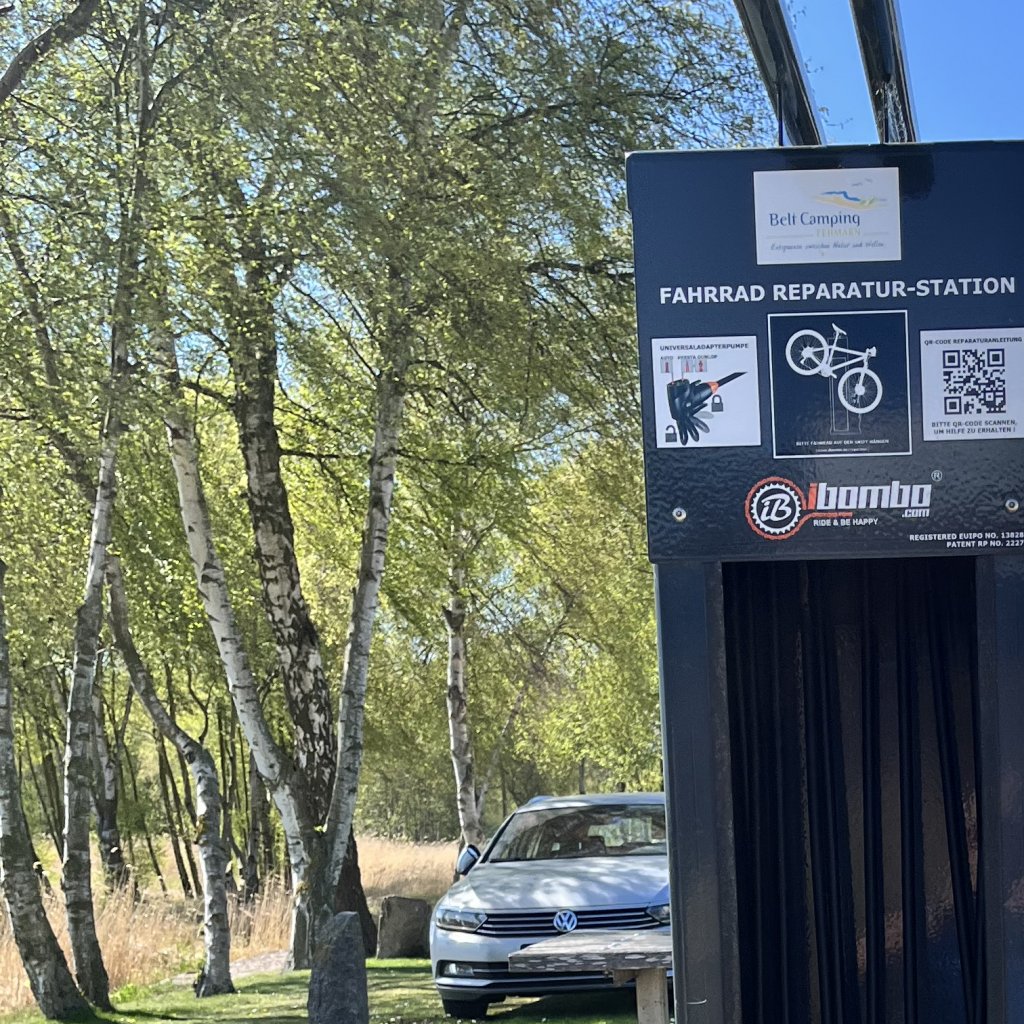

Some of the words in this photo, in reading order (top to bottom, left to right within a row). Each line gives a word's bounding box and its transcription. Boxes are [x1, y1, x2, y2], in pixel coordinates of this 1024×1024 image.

[769, 212, 796, 227] Belt
[800, 211, 860, 228] Camping
[660, 284, 765, 304] FAHRRAD
[773, 277, 1015, 301] REPARATUR-STATION
[924, 338, 951, 346] QR-CODE
[660, 343, 749, 351] UNIVERSALADAPTERPUMPE
[808, 480, 932, 510] ibombo
[901, 508, 930, 518] .com
[813, 519, 832, 527] RIDE
[833, 518, 839, 526] &
[840, 518, 851, 526] BE
[852, 518, 878, 526] HAPPY
[909, 533, 957, 541] REGISTERED
